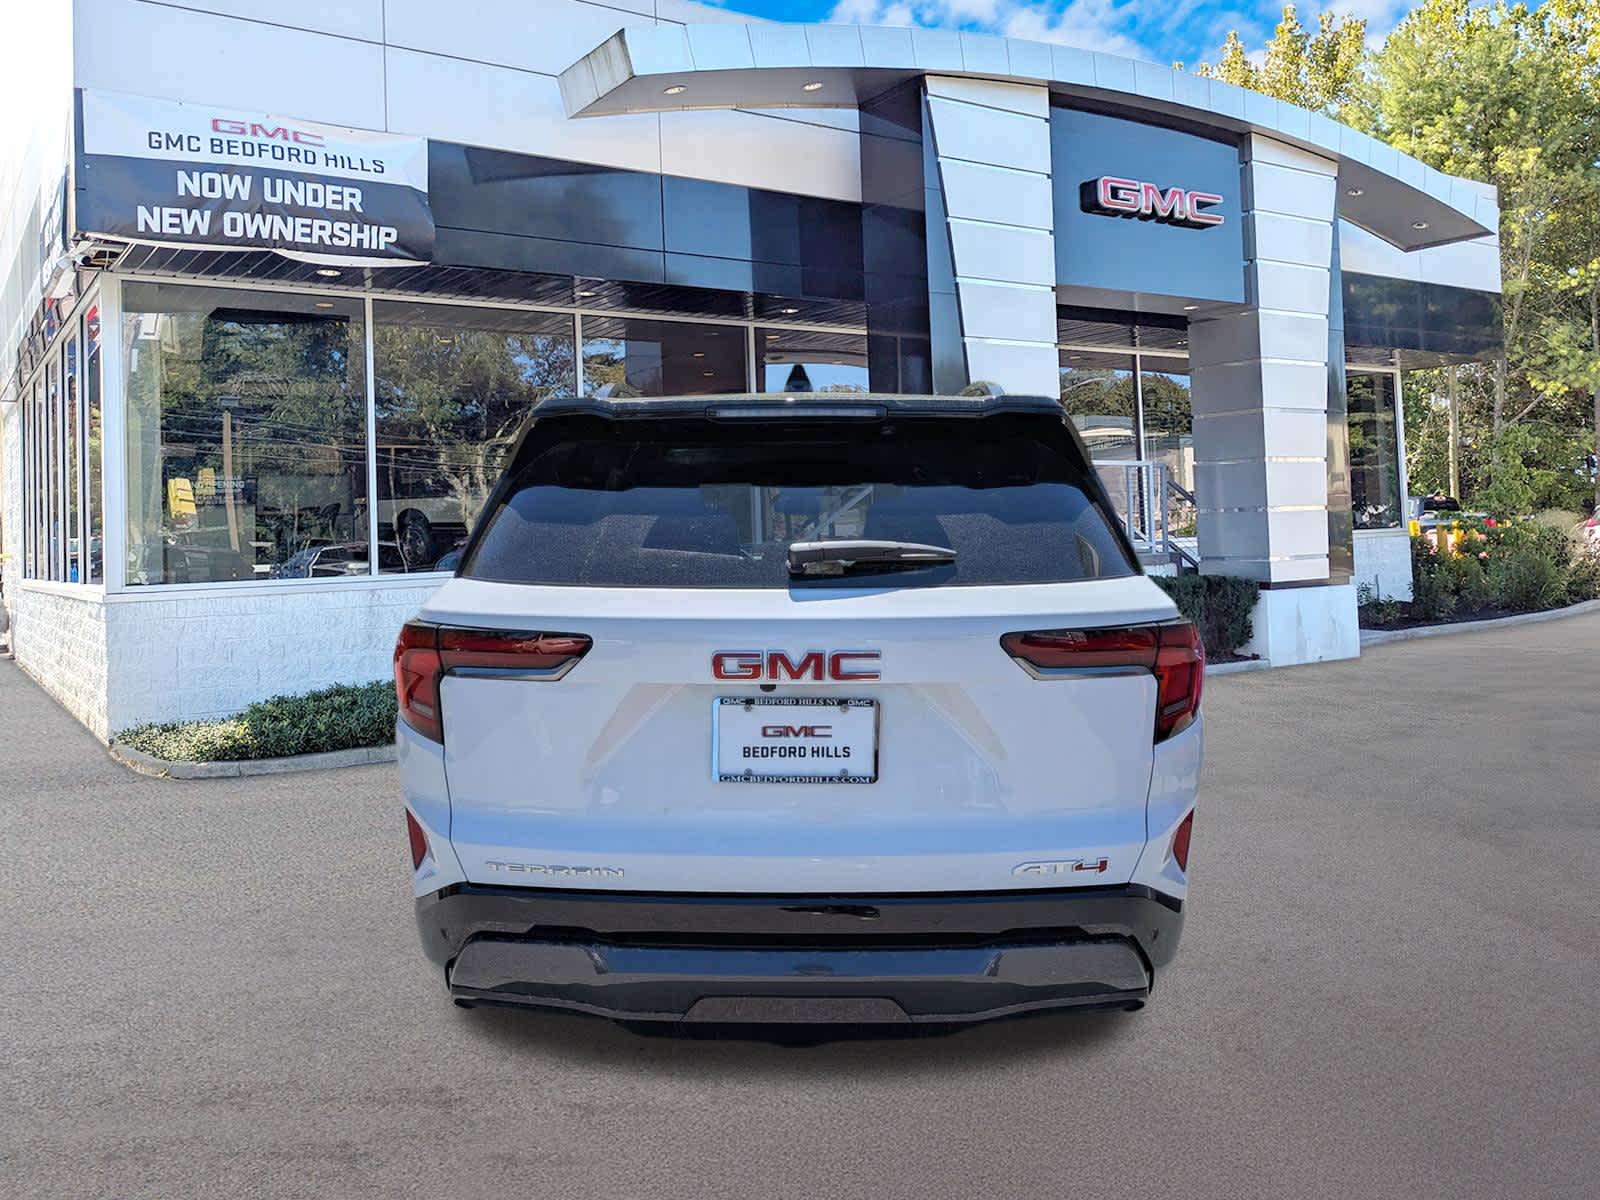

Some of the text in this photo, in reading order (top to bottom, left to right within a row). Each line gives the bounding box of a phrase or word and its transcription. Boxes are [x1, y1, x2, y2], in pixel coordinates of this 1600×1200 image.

[211, 118, 326, 148] GMC
[148, 131, 385, 174] GMC BEDFORD HILLS
[177, 170, 363, 212] NOW UNDER
[1097, 175, 1225, 225] GMC
[136, 206, 398, 250] NEW OWNERSHIP
[712, 650, 881, 681] GMC
[722, 698, 746, 706] GMC
[754, 698, 797, 706] BEDFORD
[799, 698, 823, 706] HILLS
[847, 699, 871, 707] GMC
[761, 725, 832, 738] GMC
[742, 746, 851, 758] BEDFORD HILLS
[485, 860, 625, 878] TERRAIN
[1011, 857, 1109, 875] AT4
